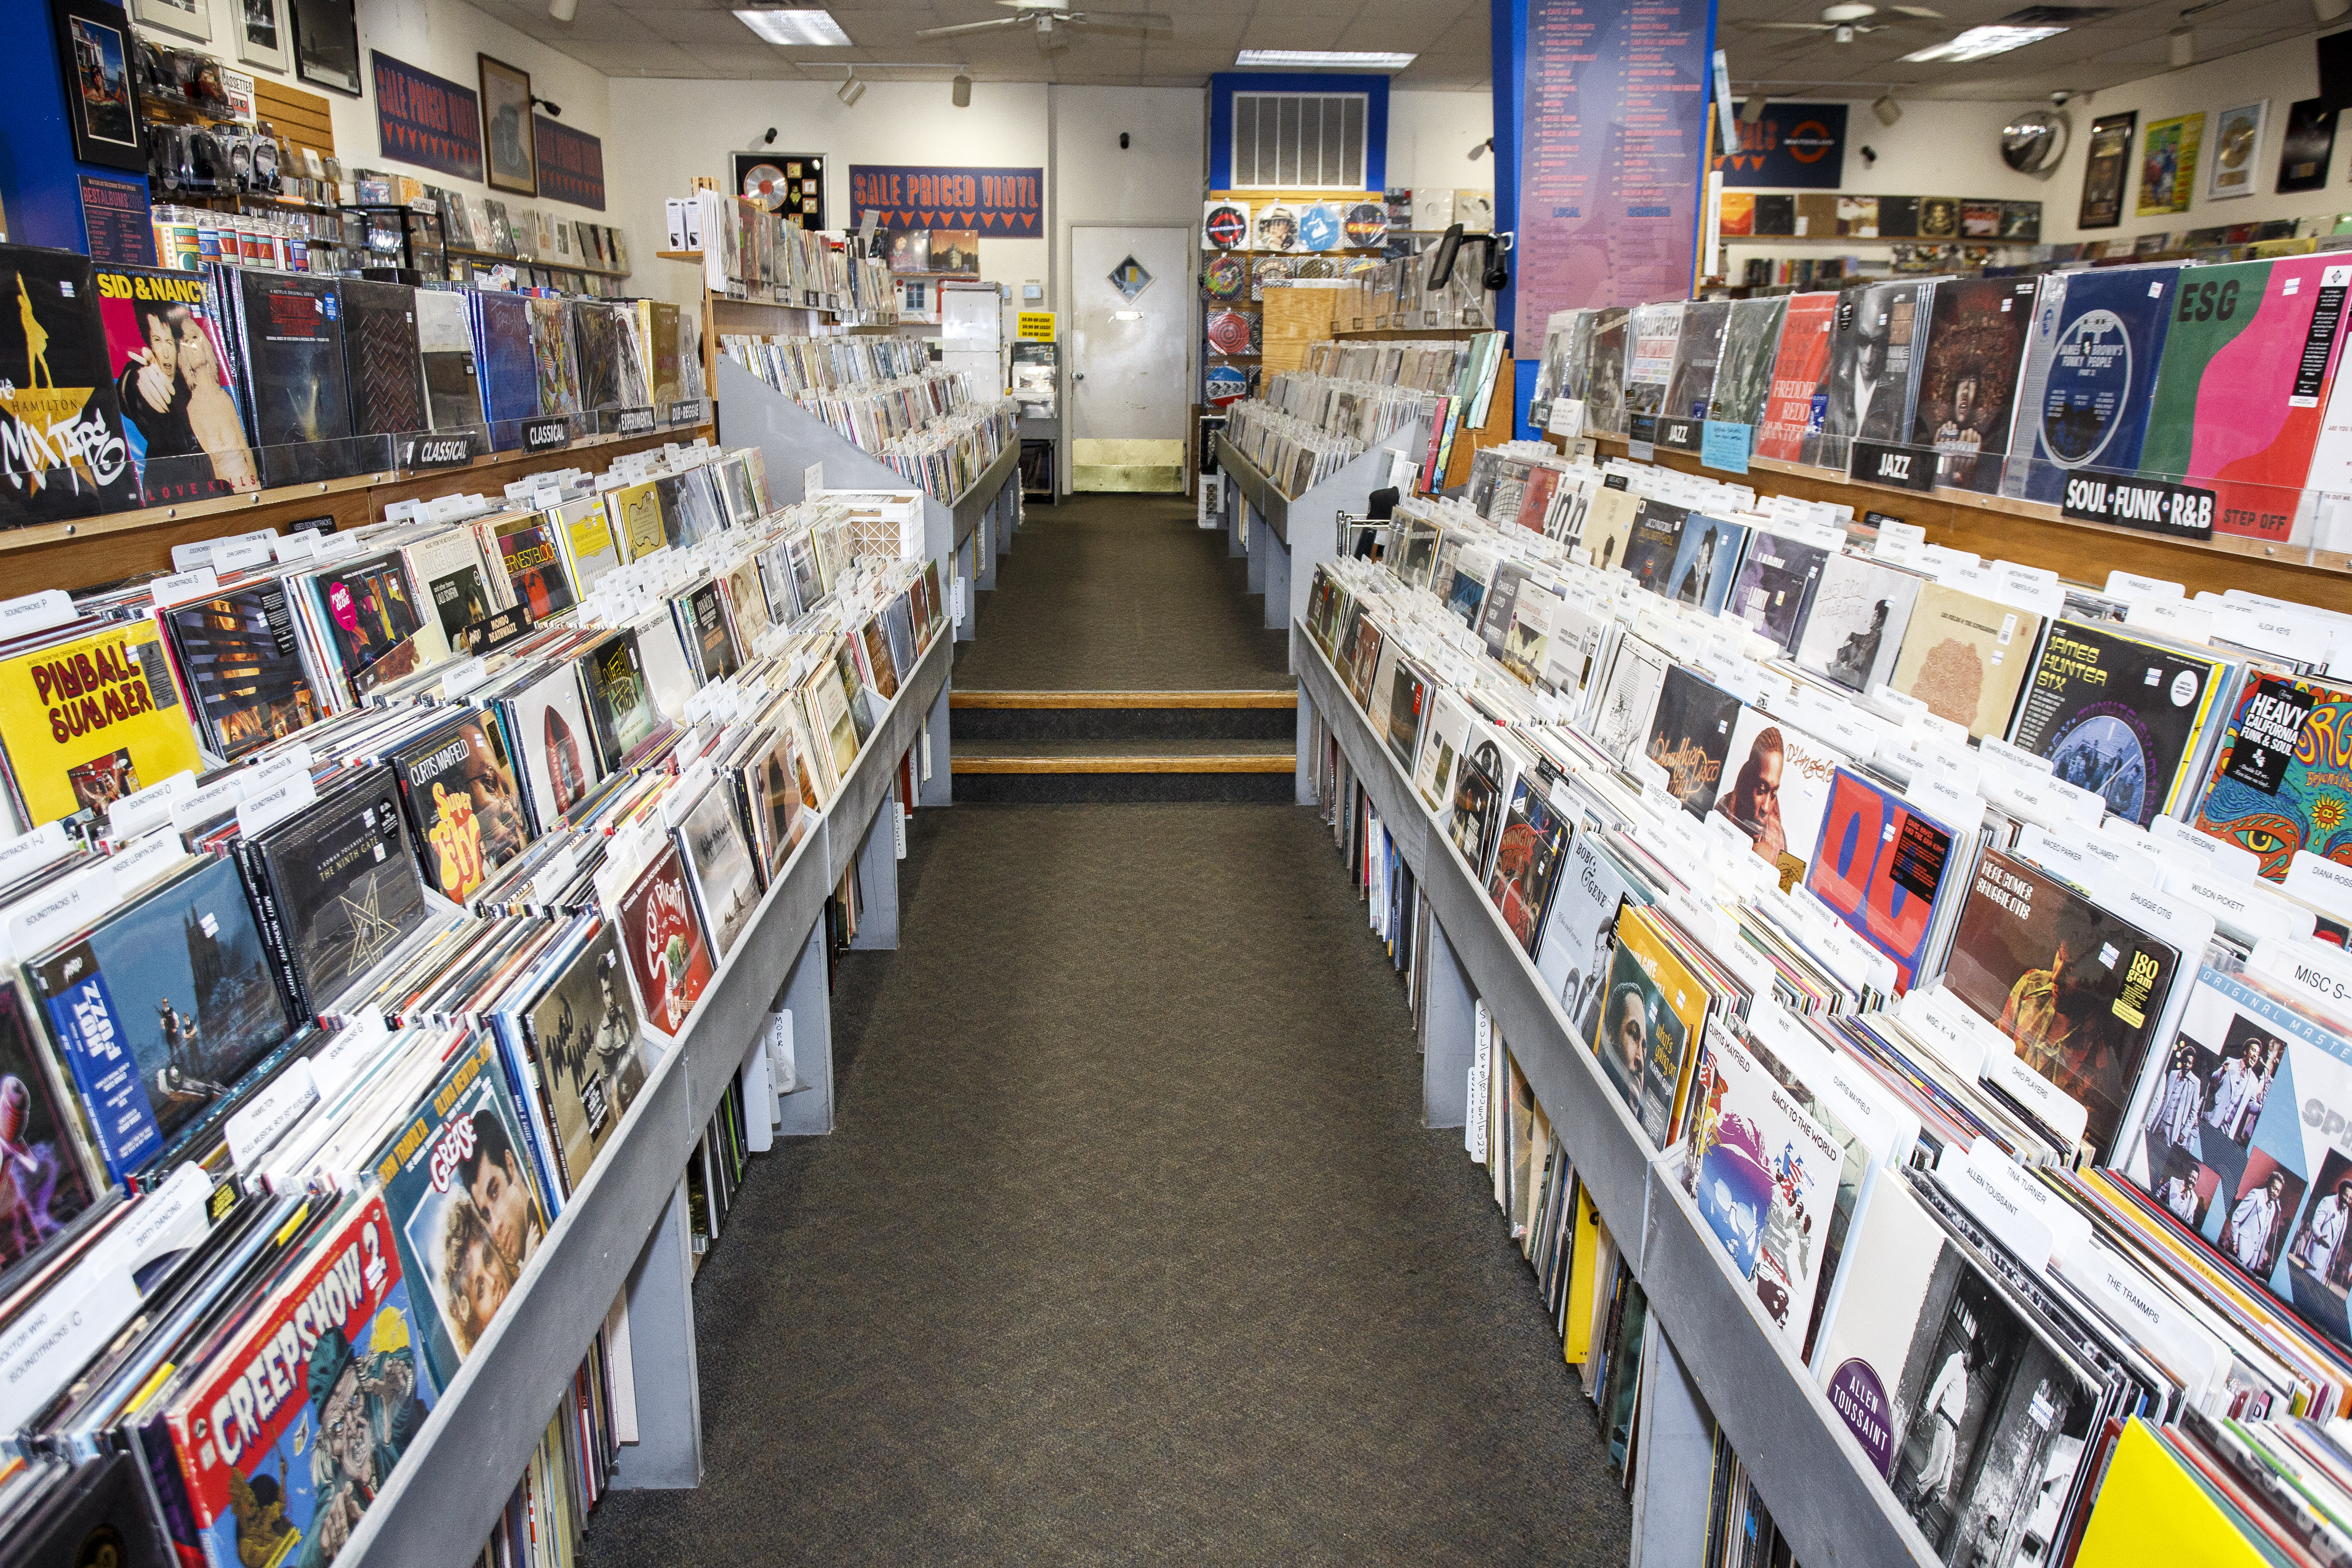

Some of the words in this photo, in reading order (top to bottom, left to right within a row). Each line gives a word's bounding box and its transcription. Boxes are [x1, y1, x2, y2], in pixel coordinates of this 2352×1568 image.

[222, 72, 253, 94] CASSETTES
[377, 65, 407, 118] SALE
[407, 78, 447, 132] PRICED
[447, 92, 479, 143] VINYL
[854, 173, 900, 205] SALE
[907, 176, 975, 206] PRICED
[982, 176, 1038, 207] VINYL
[1553, 207, 1581, 218] LOCAL
[98, 275, 133, 299] SID
[135, 279, 151, 299] &
[152, 279, 209, 303] NANCY
[2177, 279, 2239, 322] ESG
[1775, 380, 1816, 400] FREDDIE
[11, 398, 79, 412] HAMILTON
[1782, 402, 1809, 420] REDD
[529, 423, 564, 444] CLASSICAL
[620, 408, 654, 431] EXPERIMENTAL
[1669, 425, 1689, 443] JAZZ
[421, 441, 466, 462] CLASSICAL
[1878, 453, 1912, 479] JAZZ
[146, 481, 199, 501] LOVE
[207, 474, 257, 490] KILLS
[2066, 479, 2107, 513] SOUL
[2113, 485, 2165, 521] FUNK
[2171, 493, 2211, 528] R&B
[294, 523, 305, 531] USED
[305, 519, 332, 529] SOUNDTRACKS
[2223, 509, 2256, 525] STEP
[2260, 515, 2287, 530] OFF
[189, 546, 211, 554] JODOROWSKY
[505, 547, 533, 573] ERNEST
[534, 542, 556, 562] BLOCH
[167, 579, 192, 589] SOUNDTRACKS
[331, 588, 346, 603] POWER
[1497, 580, 1515, 596] CHARLES
[4, 603, 41, 617] SOUNDTRACKS
[41, 599, 47, 608] P
[336, 595, 350, 611] GLOVE
[488, 624, 517, 644] DEATHWALTZ
[490, 615, 509, 631] MONDO
[2258, 622, 2273, 633] ALICIA
[2276, 627, 2291, 636] KEYS
[1588, 643, 1596, 655] 37
[2047, 636, 2100, 663] JAMES
[31, 641, 141, 706] PINBALL
[2037, 670, 2066, 691] SIX
[2042, 653, 2107, 686] HUNTER
[49, 680, 153, 743] SUMMER
[2250, 693, 2310, 730] HEAVY
[2240, 726, 2264, 744] FUNK
[2262, 735, 2270, 747] &
[2270, 738, 2292, 756] SOUL
[2245, 714, 2298, 744] CALIFORNIA
[259, 760, 286, 779] SOUNDTRACKS
[286, 756, 292, 765] N
[411, 757, 437, 787] CURTIS
[439, 739, 470, 774] MAYFIELD
[130, 790, 164, 810] SOUNDTRACKS
[250, 793, 280, 813] SOUNDTRACKS
[280, 789, 287, 798] M
[432, 782, 471, 821] Super
[1647, 784, 1662, 798] LOUNGE
[1661, 794, 1678, 810] EXOTICA
[1933, 783, 1946, 793] ISAAC
[1946, 788, 1958, 799] HAYES
[2043, 838, 2060, 852] MACEO
[2060, 847, 2082, 862] PARKER
[2086, 842, 2119, 862] PARLIAMENT
[2177, 830, 2190, 841] OTIS
[2190, 834, 2216, 852] REDDING
[112, 861, 129, 874] INSIDE
[129, 847, 149, 867] LLEWYN
[149, 840, 164, 855] DAVIS
[319, 867, 335, 882] THE
[336, 852, 359, 872] NINTH
[359, 835, 379, 855] GATE
[429, 814, 484, 904] Fly
[1982, 861, 2003, 884] HERE
[2003, 872, 2033, 899] COMES
[2312, 867, 2332, 879] DIANA
[2333, 874, 2352, 887] ROSS
[25, 896, 70, 926] SOUNDTRACKS
[71, 890, 80, 904] H
[1588, 880, 1608, 908] GENE
[1680, 896, 1690, 908] MARVIN
[1689, 905, 1698, 916] GAYE
[1976, 878, 2010, 909] SHUGGIE
[2009, 896, 2030, 920] OTIS
[2130, 893, 2156, 912] SHUGGIE
[2156, 905, 2172, 920] OTIS
[2191, 883, 2216, 901] WILSON
[2217, 894, 2244, 912] PICKETT
[1734, 941, 1745, 955] GLORIA
[1744, 951, 1759, 967] GAYNOR
[1850, 937, 1862, 949] MAYER
[1862, 945, 1882, 967] HAWTHORNE
[2131, 951, 2159, 979] 180
[2126, 969, 2153, 989] gram
[2203, 969, 2280, 1019] ORIGINAL
[73, 1002, 105, 1058] HOT
[83, 980, 122, 1061] FUZZ
[1779, 1018, 1789, 1032] MAZE
[330, 1030, 357, 1061] SOUNDTRACKS
[357, 1022, 364, 1033] G
[1656, 1022, 1673, 1054] what's
[1708, 1023, 1726, 1047] CURTIS
[1725, 1038, 1750, 1072] MAYFIELD
[1833, 1076, 1850, 1094] CURTIS
[1849, 1090, 1870, 1114] MAYFIELD
[2012, 1066, 2024, 1080] OHIO
[2025, 1075, 2048, 1099] PLAYERS
[250, 1098, 275, 1120] HAMILTON
[433, 1083, 457, 1117] OLIVIA
[1772, 1089, 1789, 1112] BACK
[1788, 1108, 1798, 1120] TO
[1798, 1116, 1812, 1135] THE
[1810, 1130, 1836, 1161] WORLD
[393, 1117, 429, 1165] TRAVOLTA
[431, 1115, 477, 1192] GREASE
[1967, 1167, 1984, 1183] ALLEN
[1986, 1181, 2017, 1215] TOUSSAINT
[2008, 1167, 2024, 1181] TINA
[2024, 1180, 2047, 1204] TURNER
[136, 1228, 153, 1247] DIRTY
[151, 1202, 182, 1231] DANCING
[2107, 1274, 2122, 1290] THE
[2123, 1287, 2159, 1323] TRAMMPS
[9, 1326, 69, 1383] SOUNDTRACKS
[71, 1311, 82, 1327] C
[211, 1241, 365, 1466] CREEPSHOW
[362, 1221, 388, 1292] 2
[1850, 1376, 1878, 1413] ALLEN
[1835, 1384, 1887, 1451] TOUSSAINT
